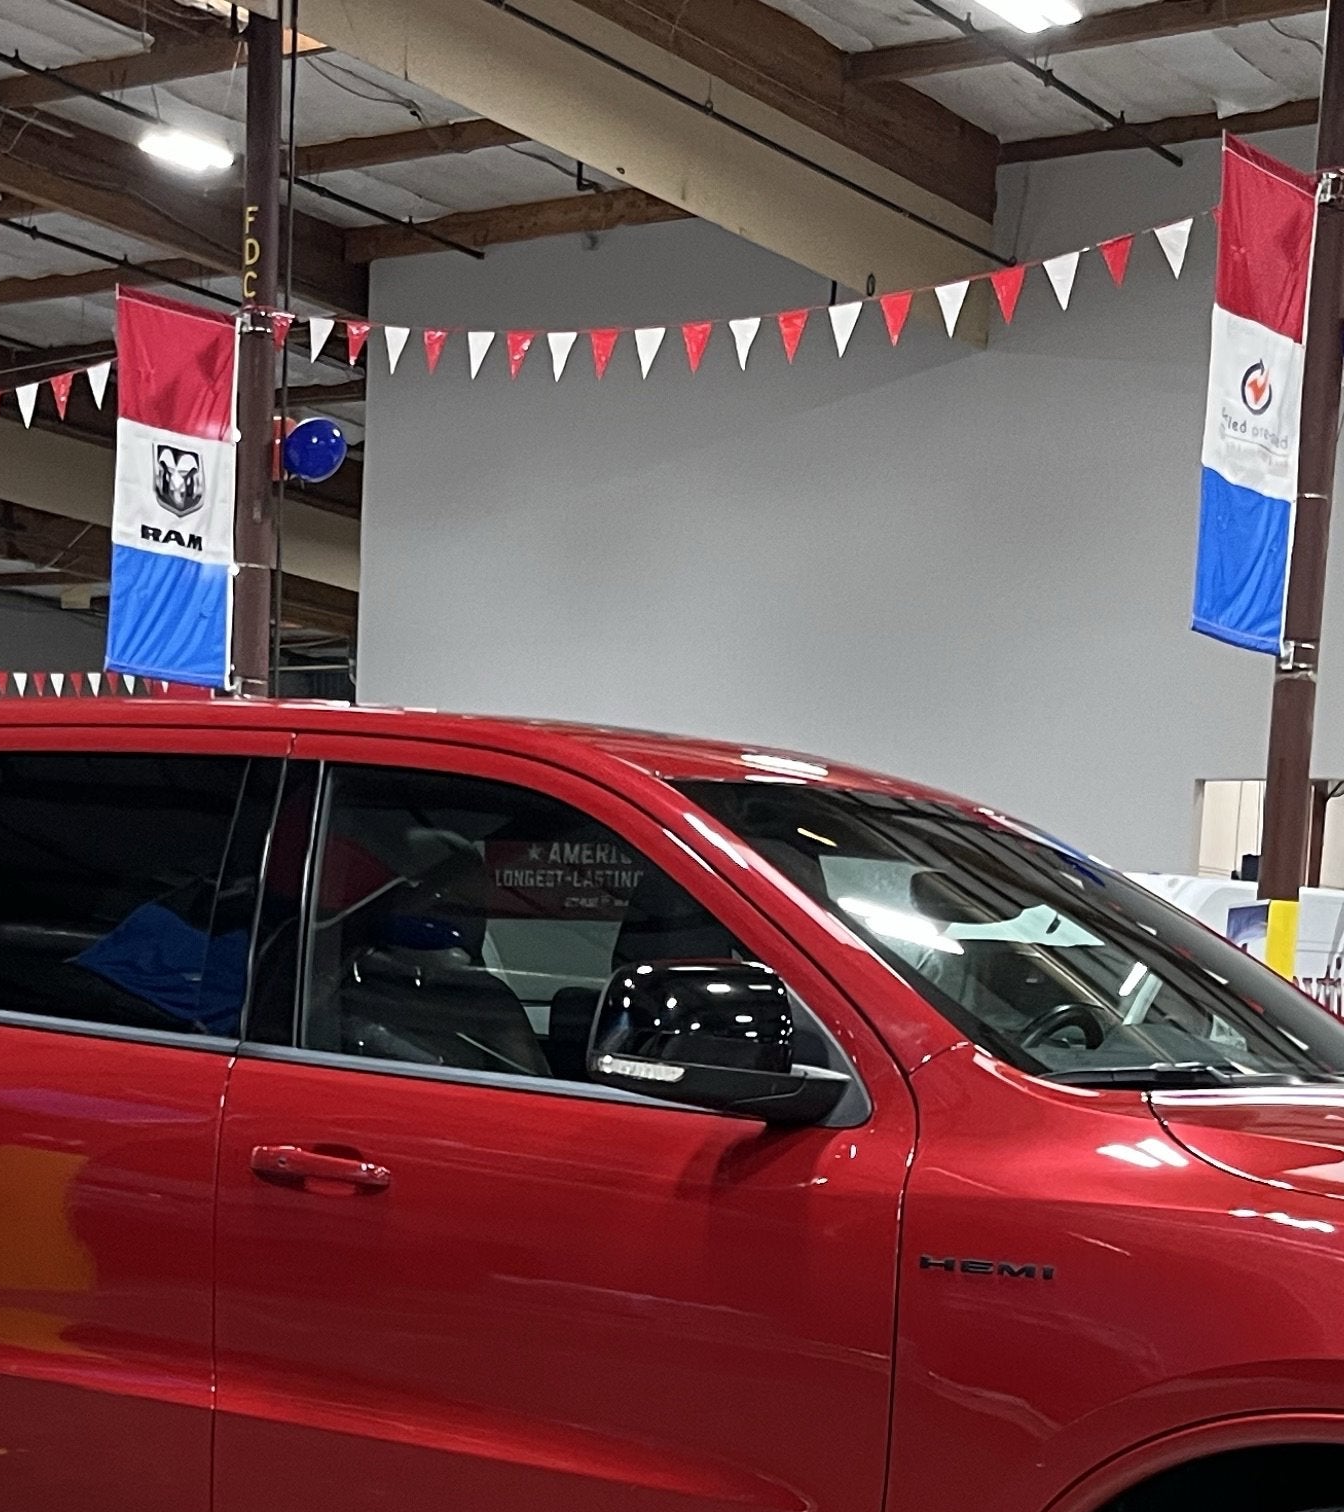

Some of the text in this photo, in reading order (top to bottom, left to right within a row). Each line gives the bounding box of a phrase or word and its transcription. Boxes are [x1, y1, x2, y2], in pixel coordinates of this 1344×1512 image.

[243, 206, 260, 298] FDC
[140, 524, 203, 552] RAM
[920, 1255, 1055, 1281] HEMI
